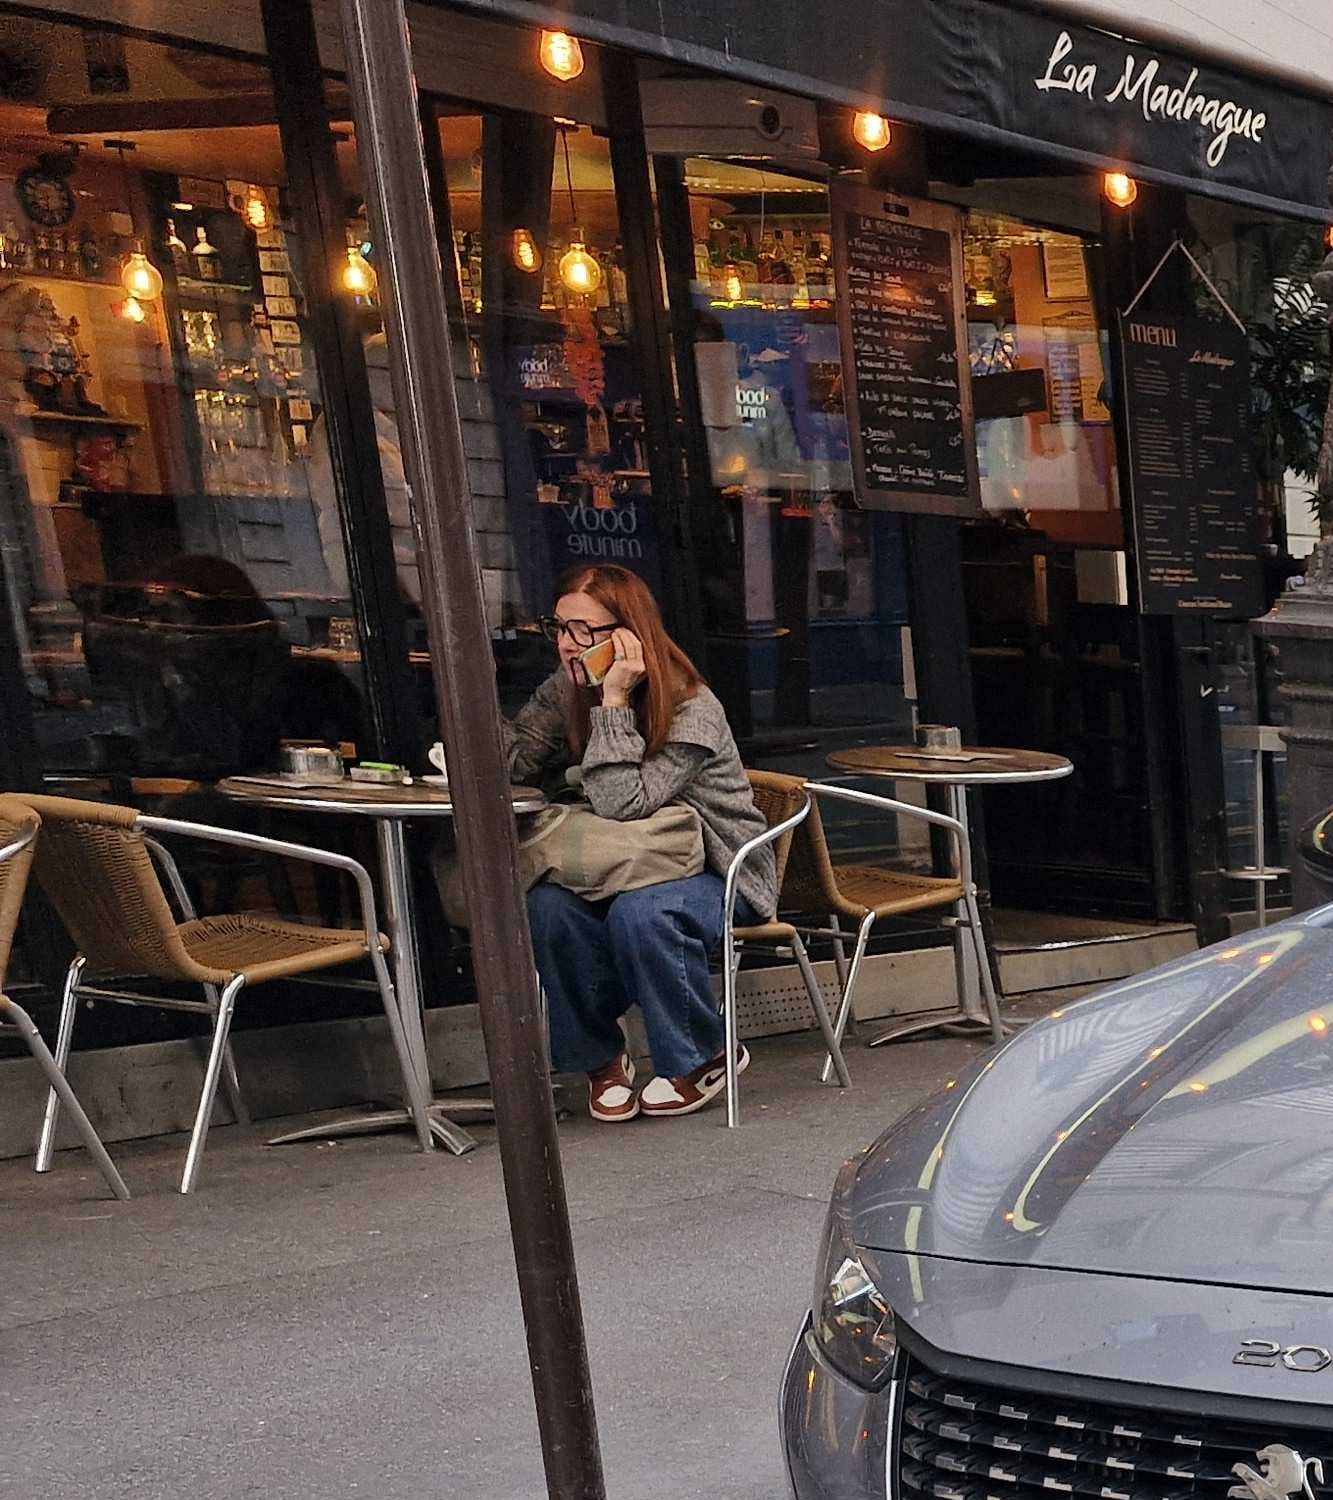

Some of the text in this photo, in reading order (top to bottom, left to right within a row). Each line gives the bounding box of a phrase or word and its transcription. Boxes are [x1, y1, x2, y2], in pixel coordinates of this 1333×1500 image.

[1035, 32, 1267, 168] La Madrague
[1130, 323, 1178, 347] menu
